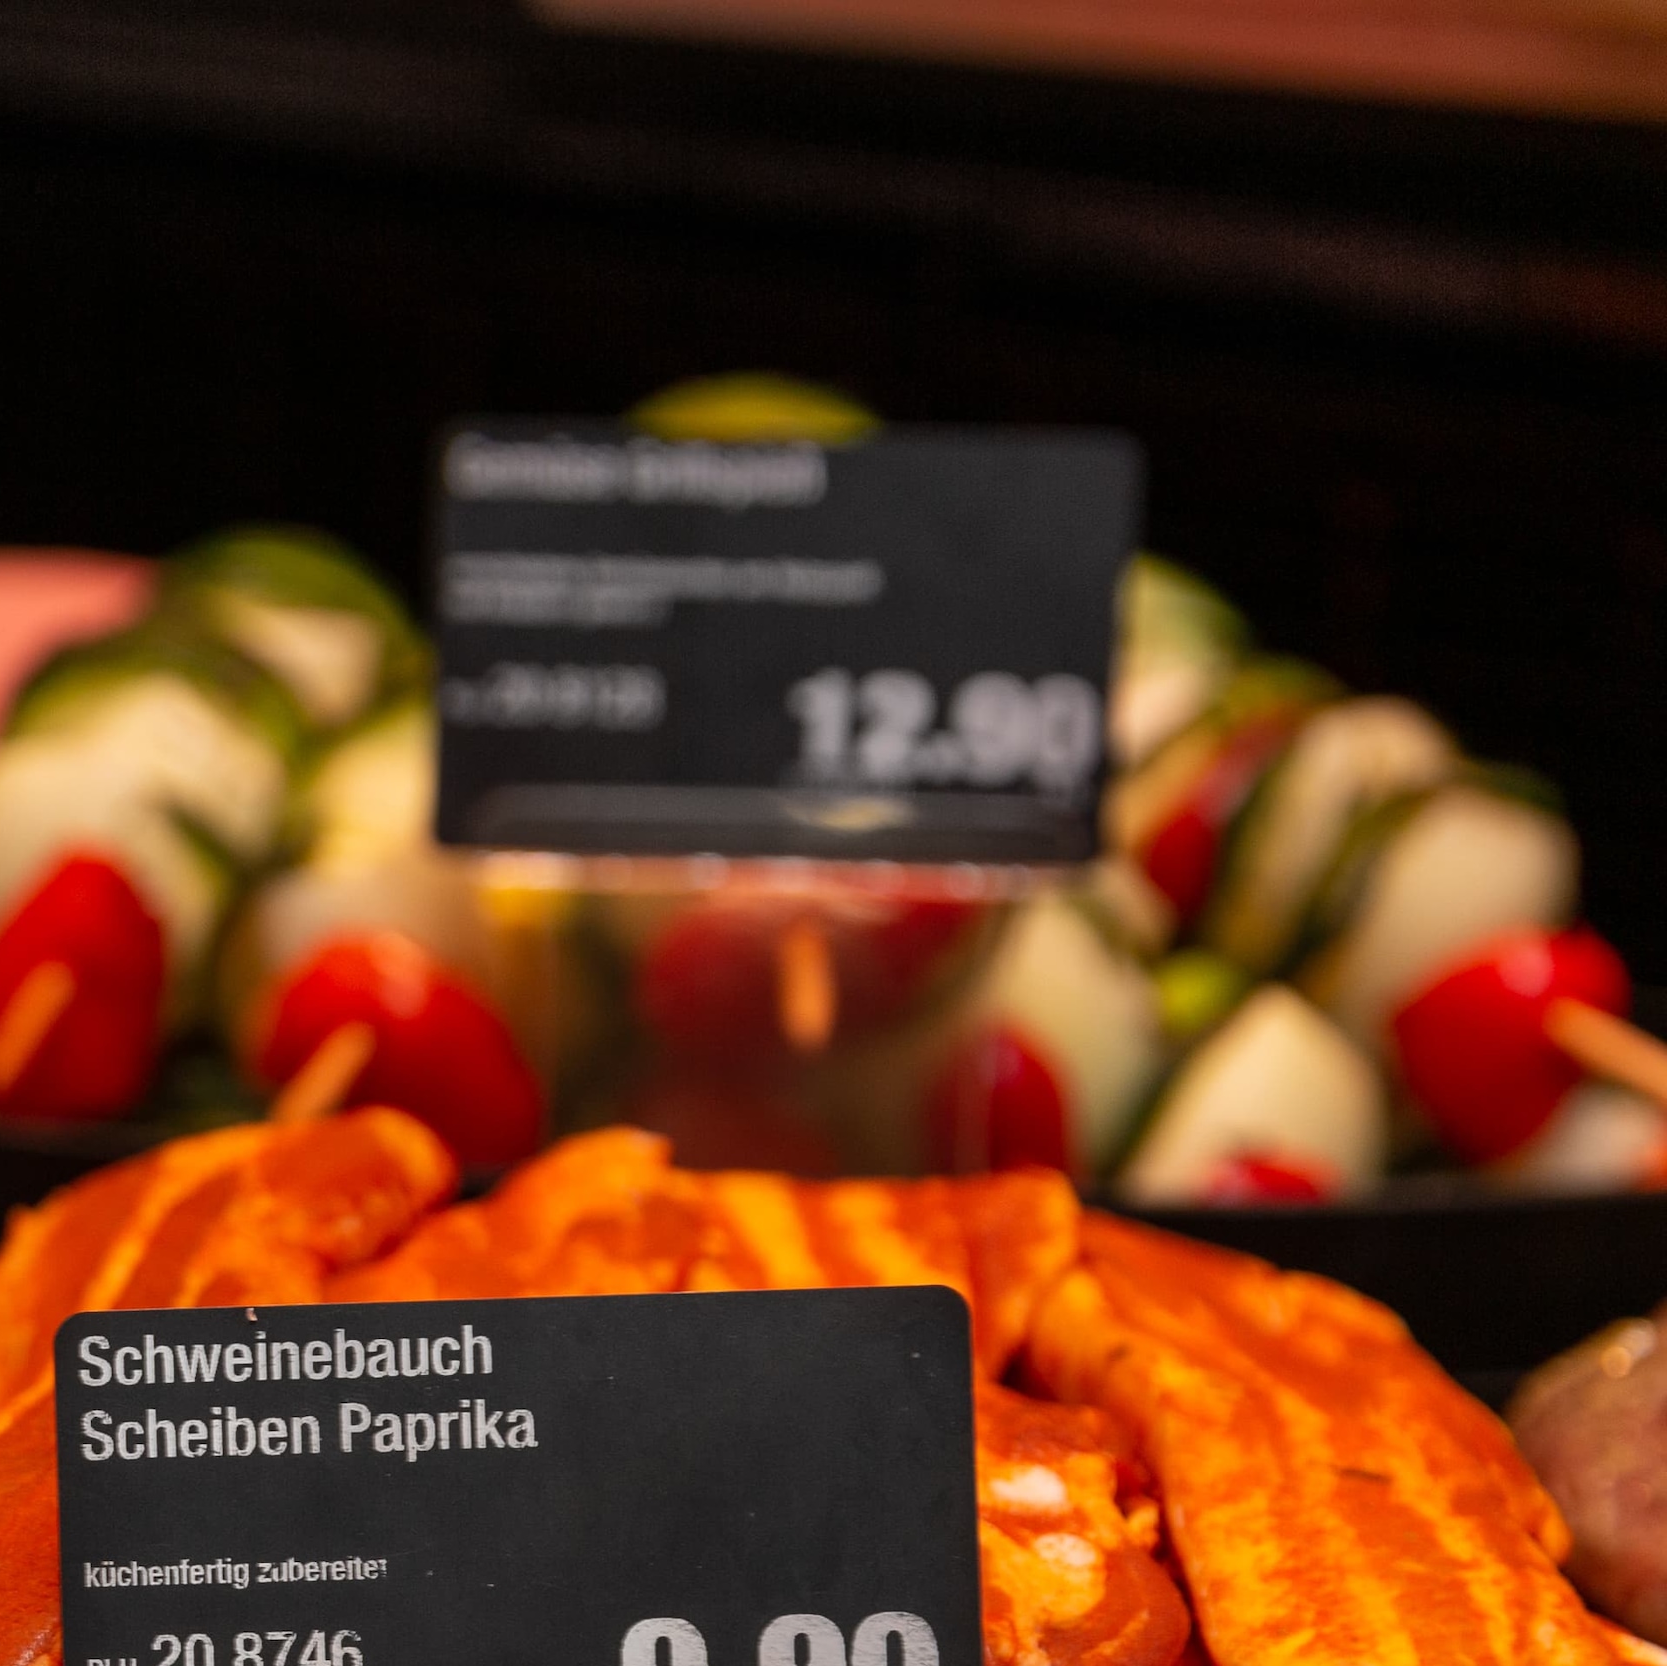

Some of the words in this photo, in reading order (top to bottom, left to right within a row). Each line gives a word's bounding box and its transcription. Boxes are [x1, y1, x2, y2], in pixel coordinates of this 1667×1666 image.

[78, 1324, 493, 1386] Schweinebauch
[80, 1407, 321, 1461] Scheiben
[338, 1398, 538, 1462] Paprika
[83, 1557, 249, 1589] küchenfertig
